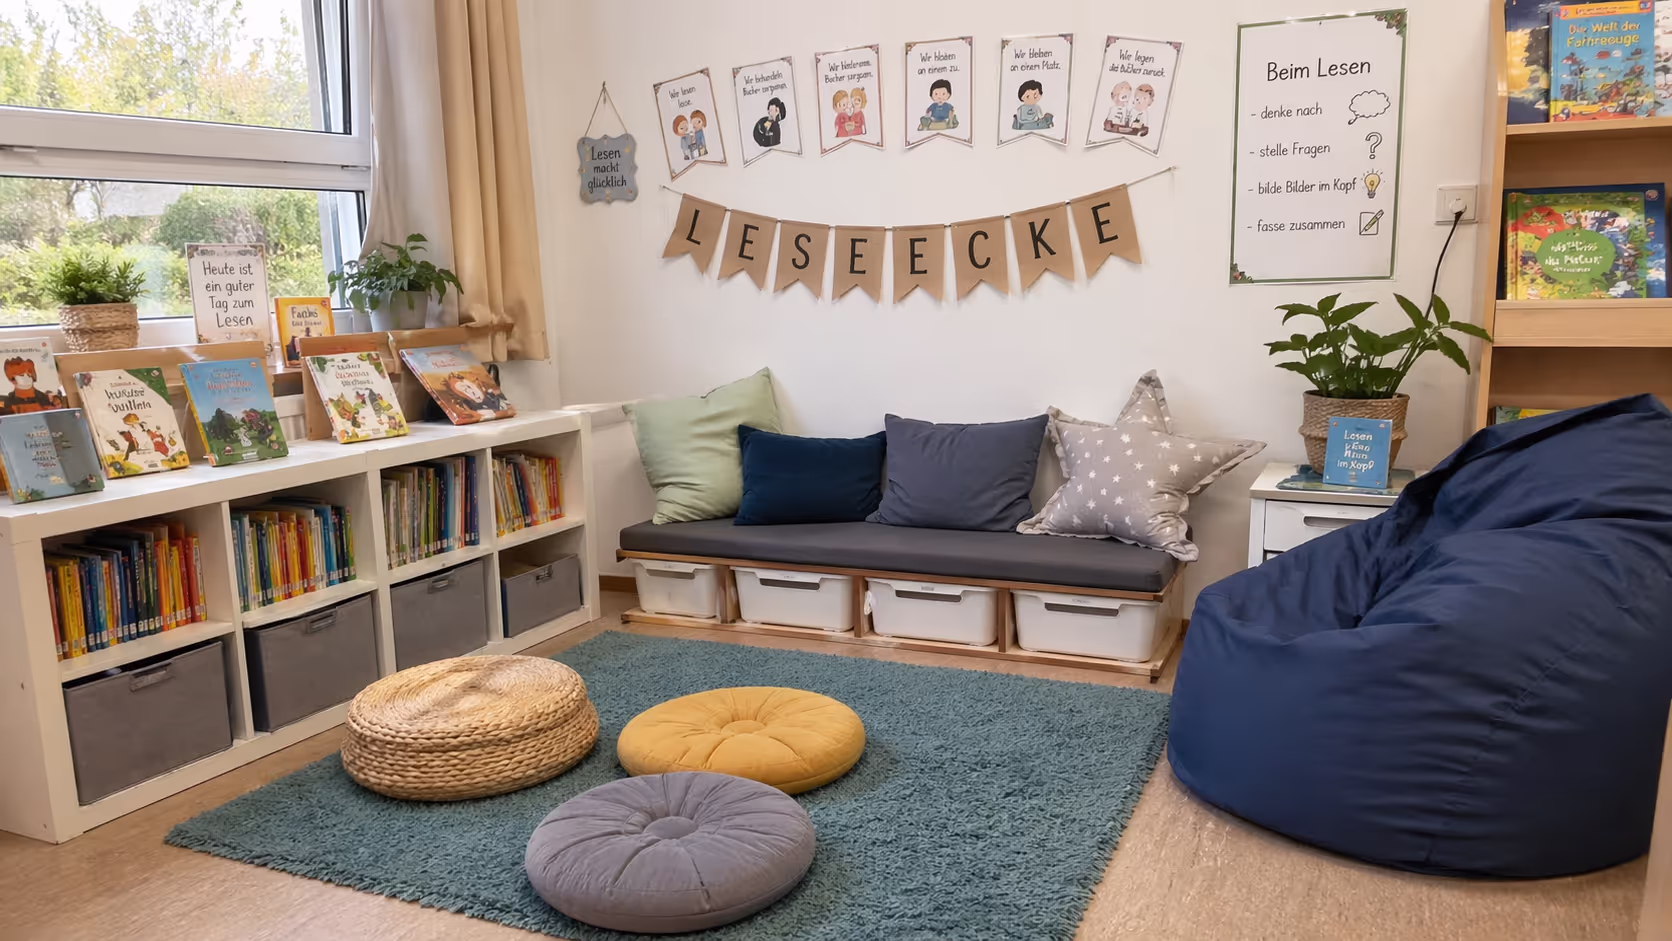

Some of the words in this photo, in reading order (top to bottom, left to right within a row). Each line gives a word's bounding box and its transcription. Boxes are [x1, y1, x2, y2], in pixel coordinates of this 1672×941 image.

[1592, 22, 1618, 32] Welt
[1134, 50, 1155, 65] legen
[1267, 62, 1310, 81] Beim
[1317, 57, 1371, 78] Lesen
[1260, 105, 1293, 119] denke
[1296, 101, 1323, 117] nach
[591, 146, 621, 161] Lesen
[1260, 143, 1288, 157] stelle
[1292, 142, 1331, 158] Fragen
[593, 162, 619, 174] macht
[588, 175, 627, 194] glücklich
[1258, 181, 1282, 194] bilde
[1286, 180, 1316, 193] Bilder
[1319, 180, 1331, 191] im
[1333, 177, 1357, 194] Kopf
[1257, 219, 1285, 232] fasse
[1289, 220, 1345, 231] zusammen
[203, 261, 235, 276] Heute
[240, 263, 254, 275] ist
[205, 281, 222, 292] ein
[225, 279, 255, 297] guter
[209, 296, 228, 313] Tag
[233, 299, 254, 309] zum
[216, 312, 254, 328] Lesen
